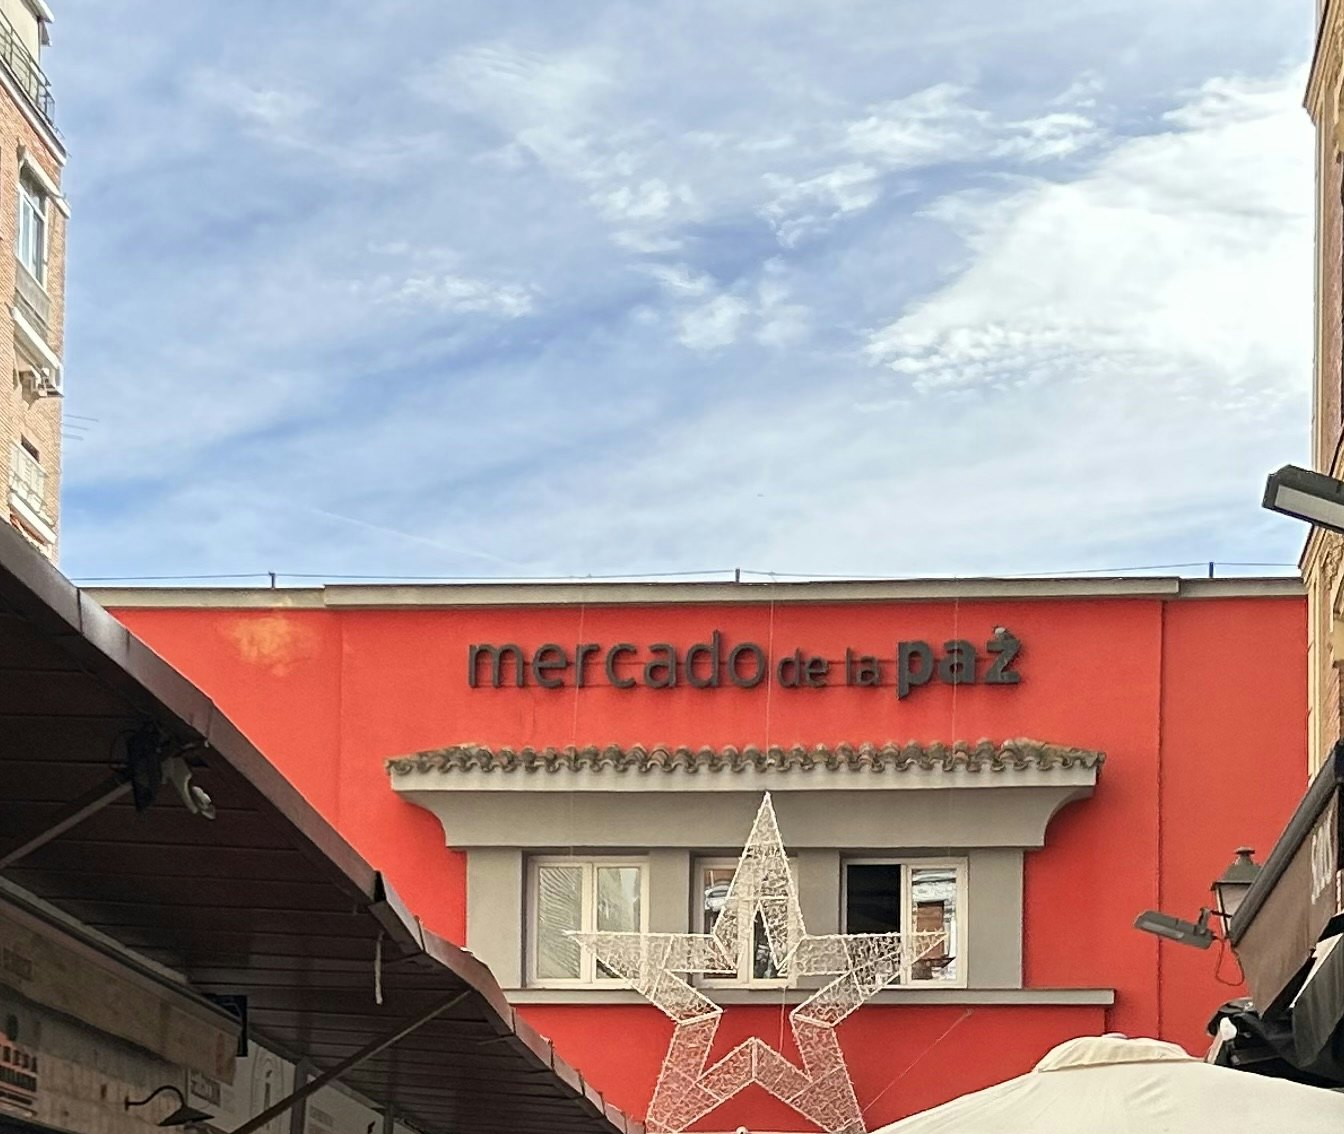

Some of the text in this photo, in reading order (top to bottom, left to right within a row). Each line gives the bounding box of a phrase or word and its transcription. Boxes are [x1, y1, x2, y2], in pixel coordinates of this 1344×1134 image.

[468, 625, 1024, 700] mercado de la paz
